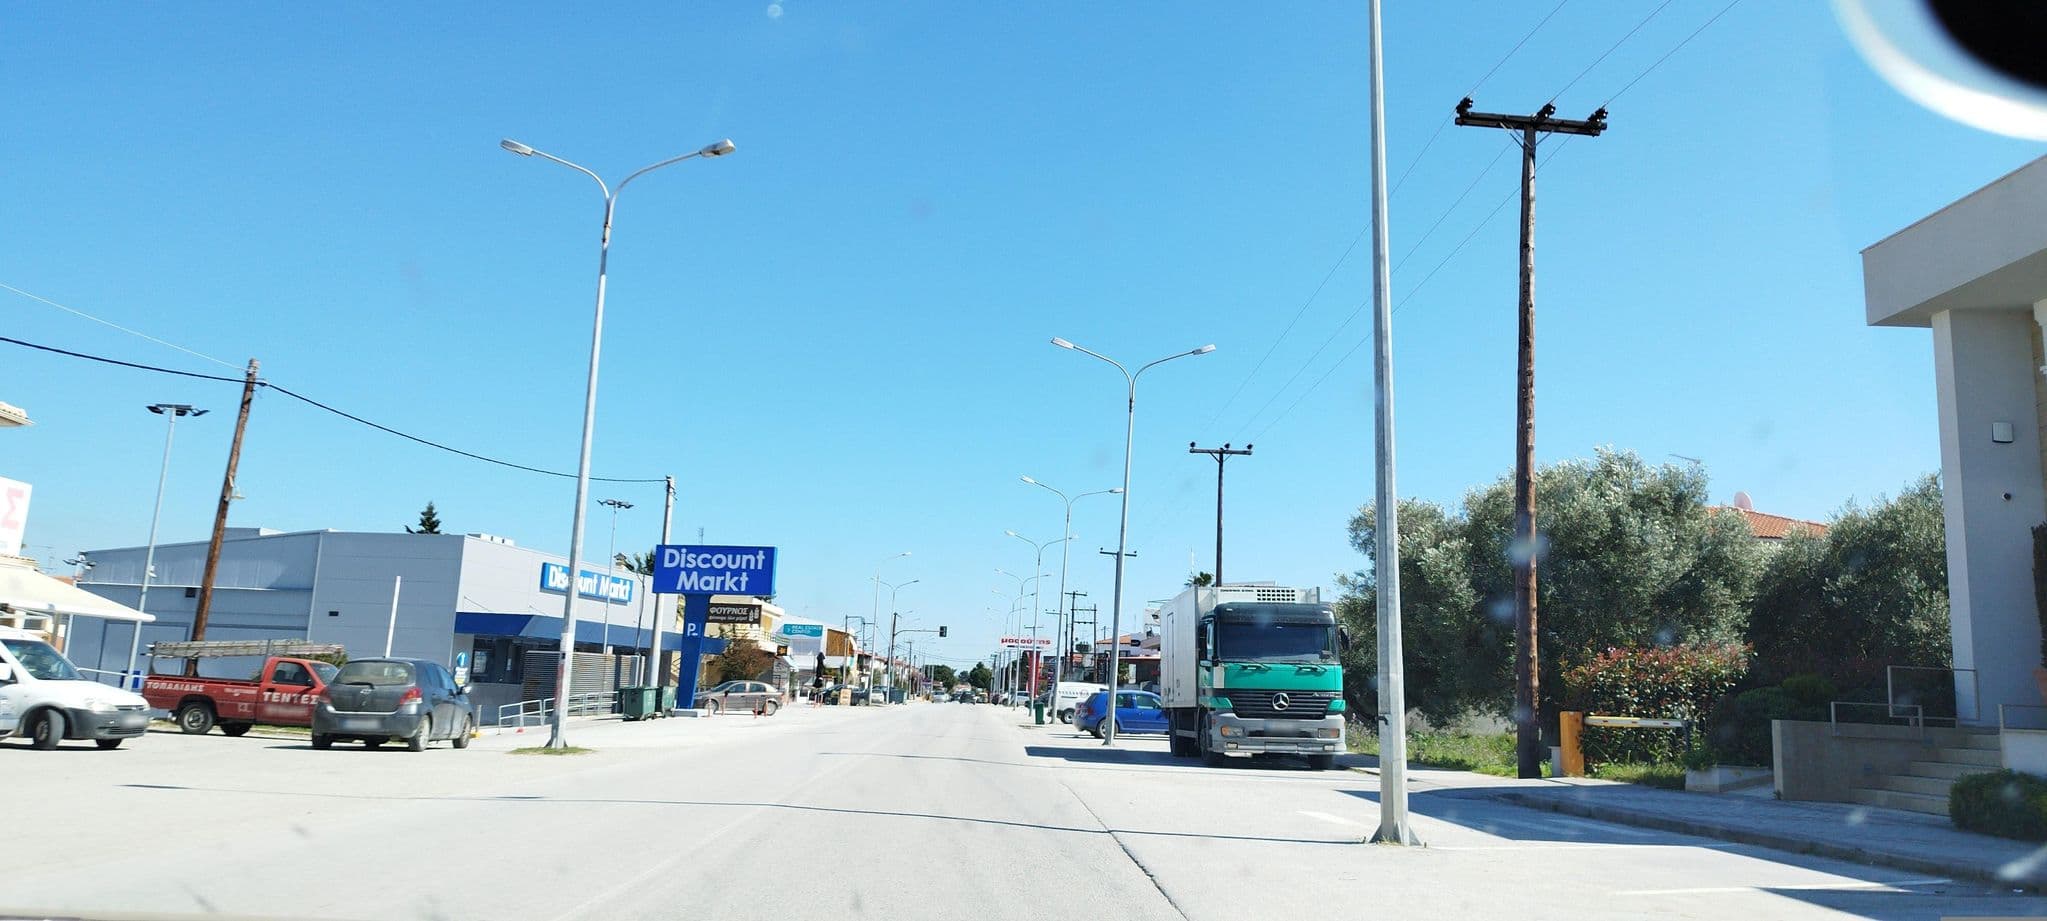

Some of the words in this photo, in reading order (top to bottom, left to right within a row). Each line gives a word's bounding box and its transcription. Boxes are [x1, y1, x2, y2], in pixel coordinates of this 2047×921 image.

[663, 548, 765, 570] Discount
[548, 564, 598, 595] Disunt
[676, 571, 749, 591] Markt
[709, 606, 749, 615] ΦΟΥΡΝΟΣ
[263, 691, 321, 705] ΤΕΝΤΕΣ
